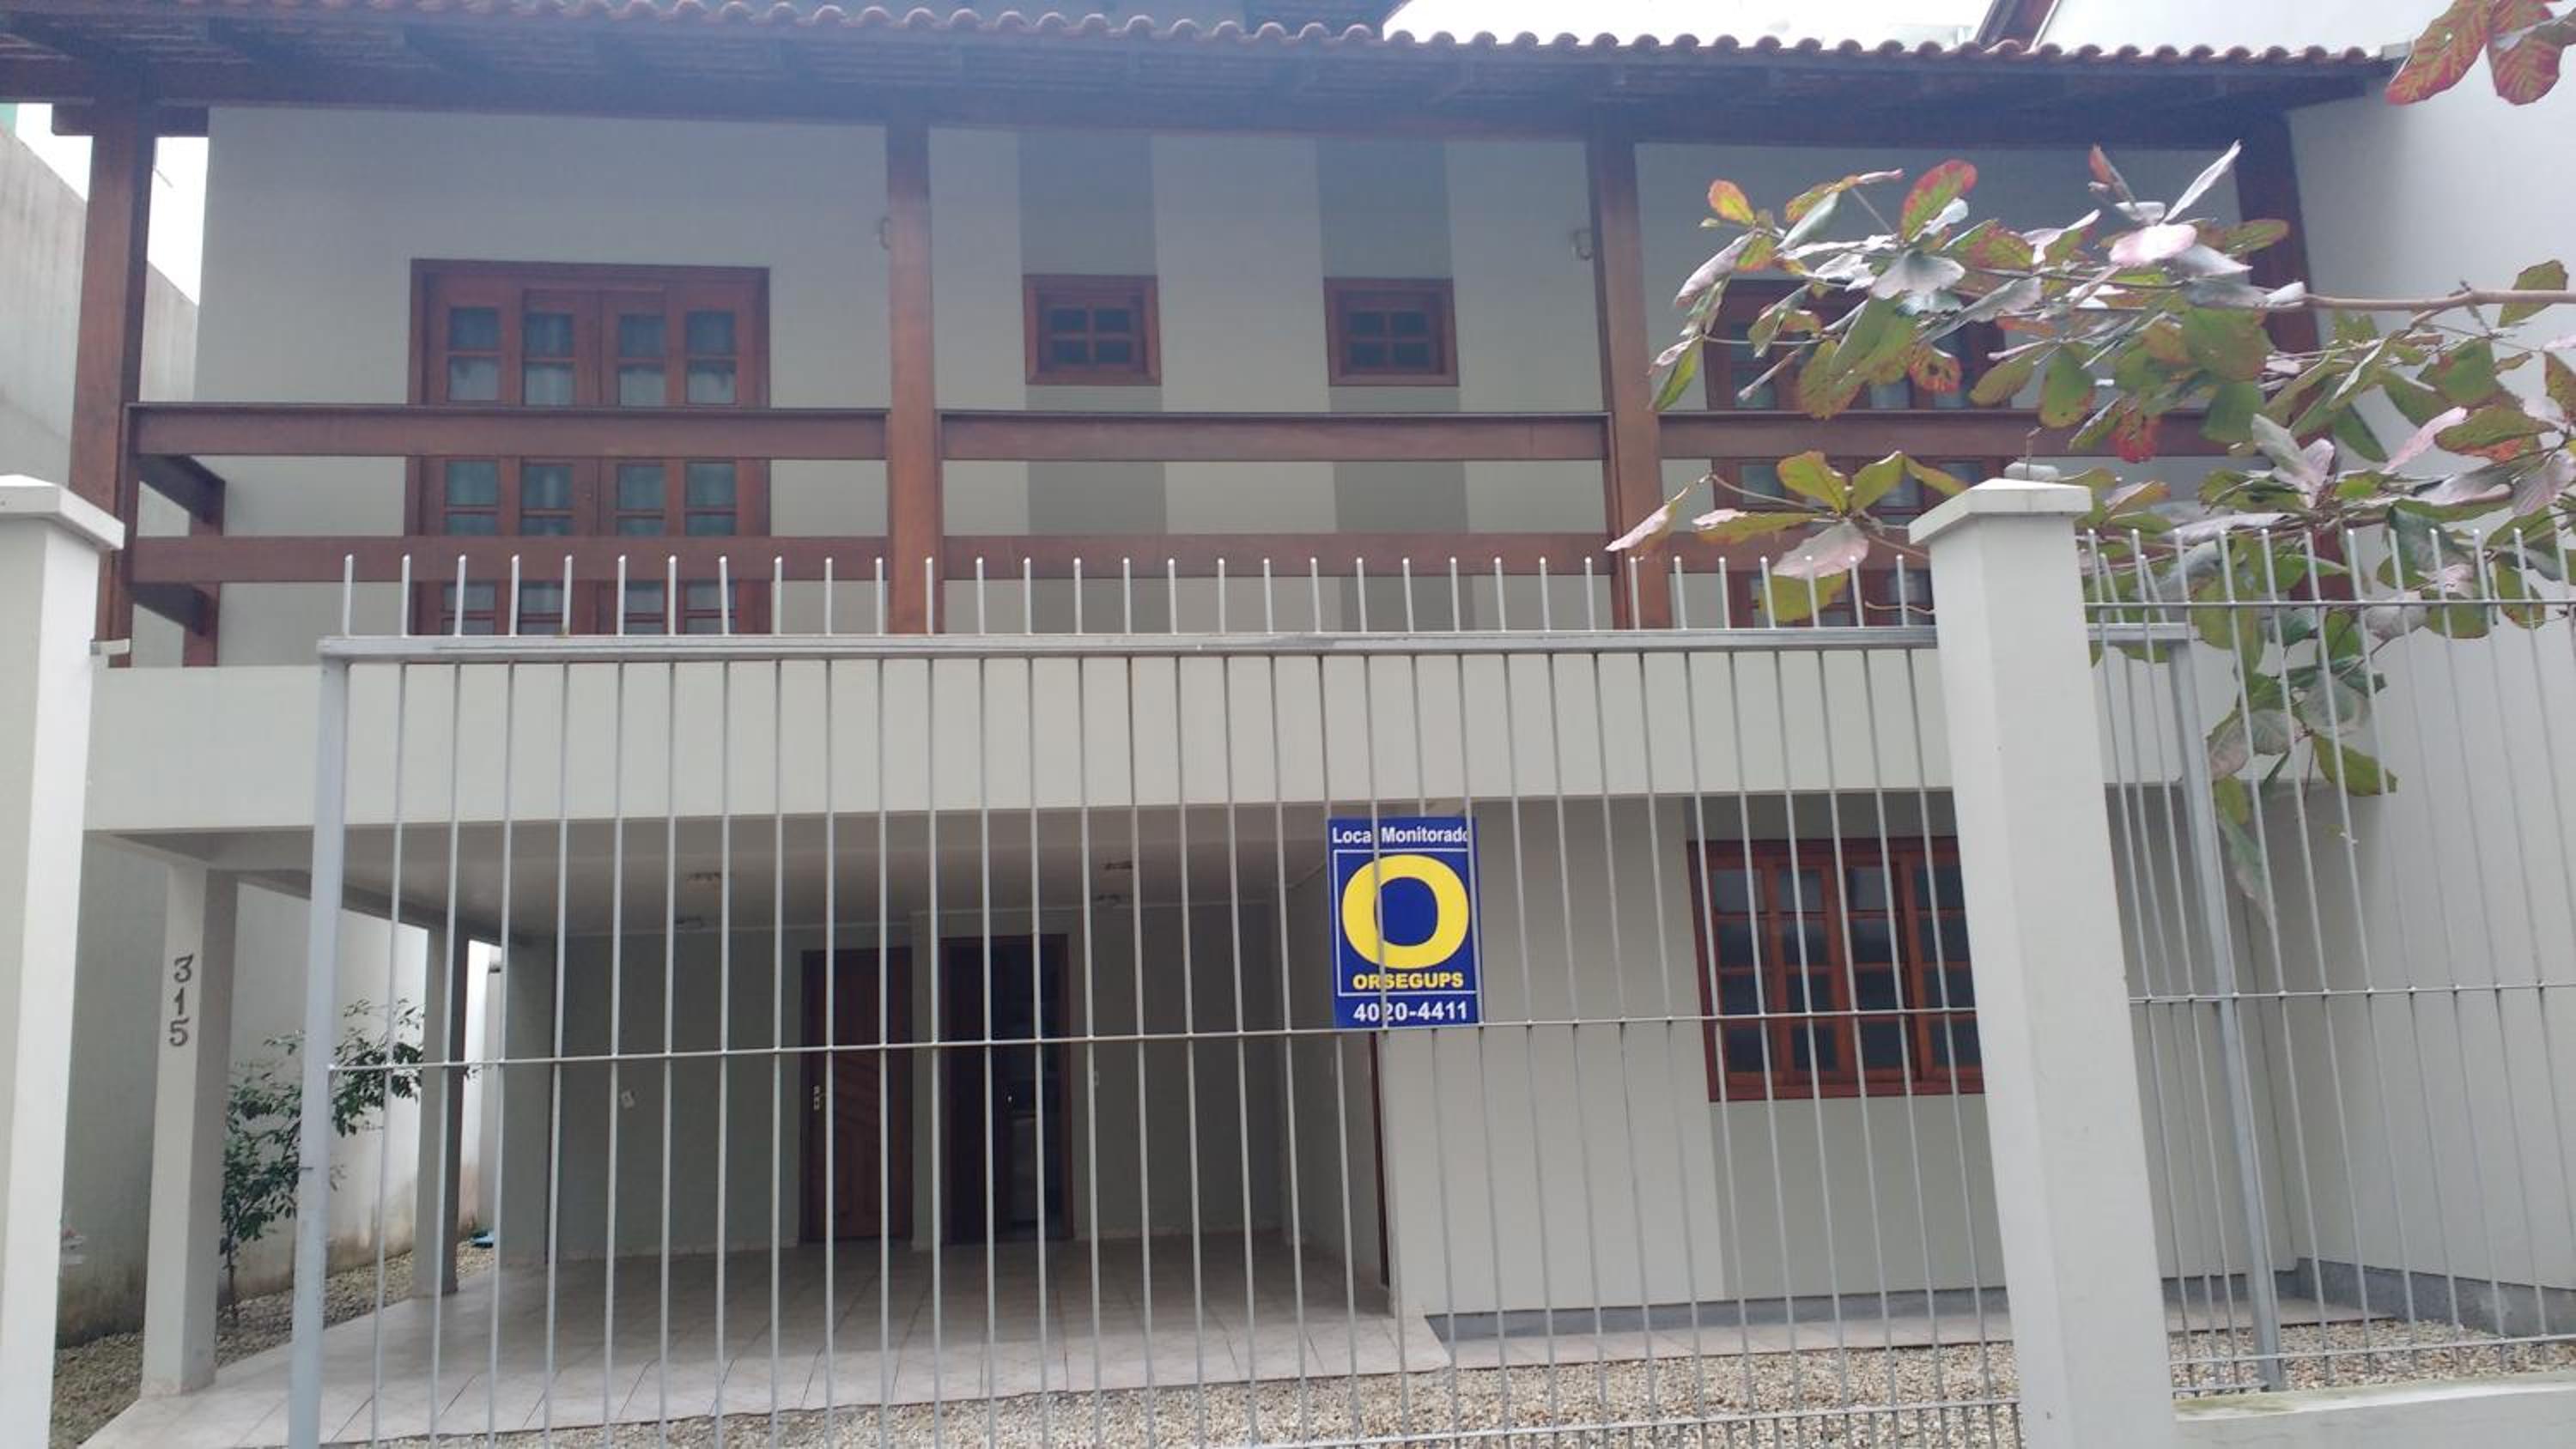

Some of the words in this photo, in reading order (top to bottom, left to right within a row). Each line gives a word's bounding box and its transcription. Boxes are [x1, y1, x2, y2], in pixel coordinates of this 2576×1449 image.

[1333, 827, 1374, 843] Loca
[1341, 854, 1469, 969] O
[169, 953, 194, 1046] 315
[1352, 973, 1464, 990] ORSEGUPS
